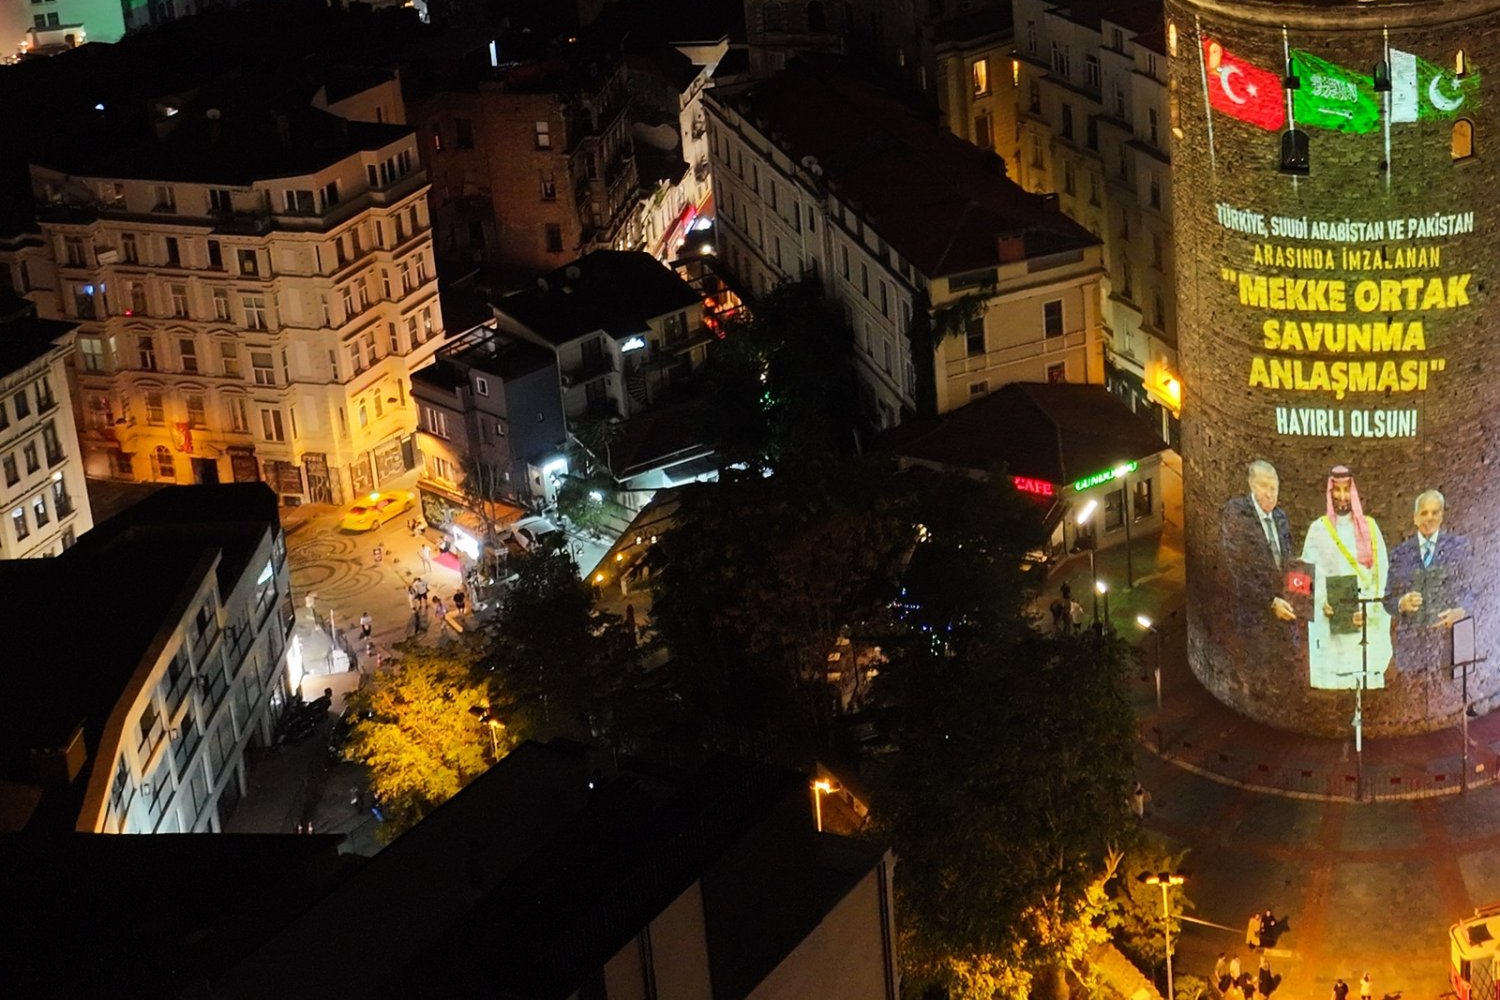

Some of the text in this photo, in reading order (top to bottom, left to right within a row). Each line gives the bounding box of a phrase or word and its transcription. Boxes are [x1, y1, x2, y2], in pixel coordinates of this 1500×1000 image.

[1216, 202, 1474, 242] TÜRKİYE, SUUDİ ARABİSTAN VE PAKİSTAN
[1254, 244, 1335, 270] ARASINDA
[1221, 268, 1472, 312] "MEKKE ORTAK
[1262, 319, 1426, 353] SAVUNMA
[1249, 357, 1446, 400] ANLAŞMASI"
[1276, 407, 1418, 438] HAYIRLI OLSUN!
[1014, 476, 1053, 496] CAFE
